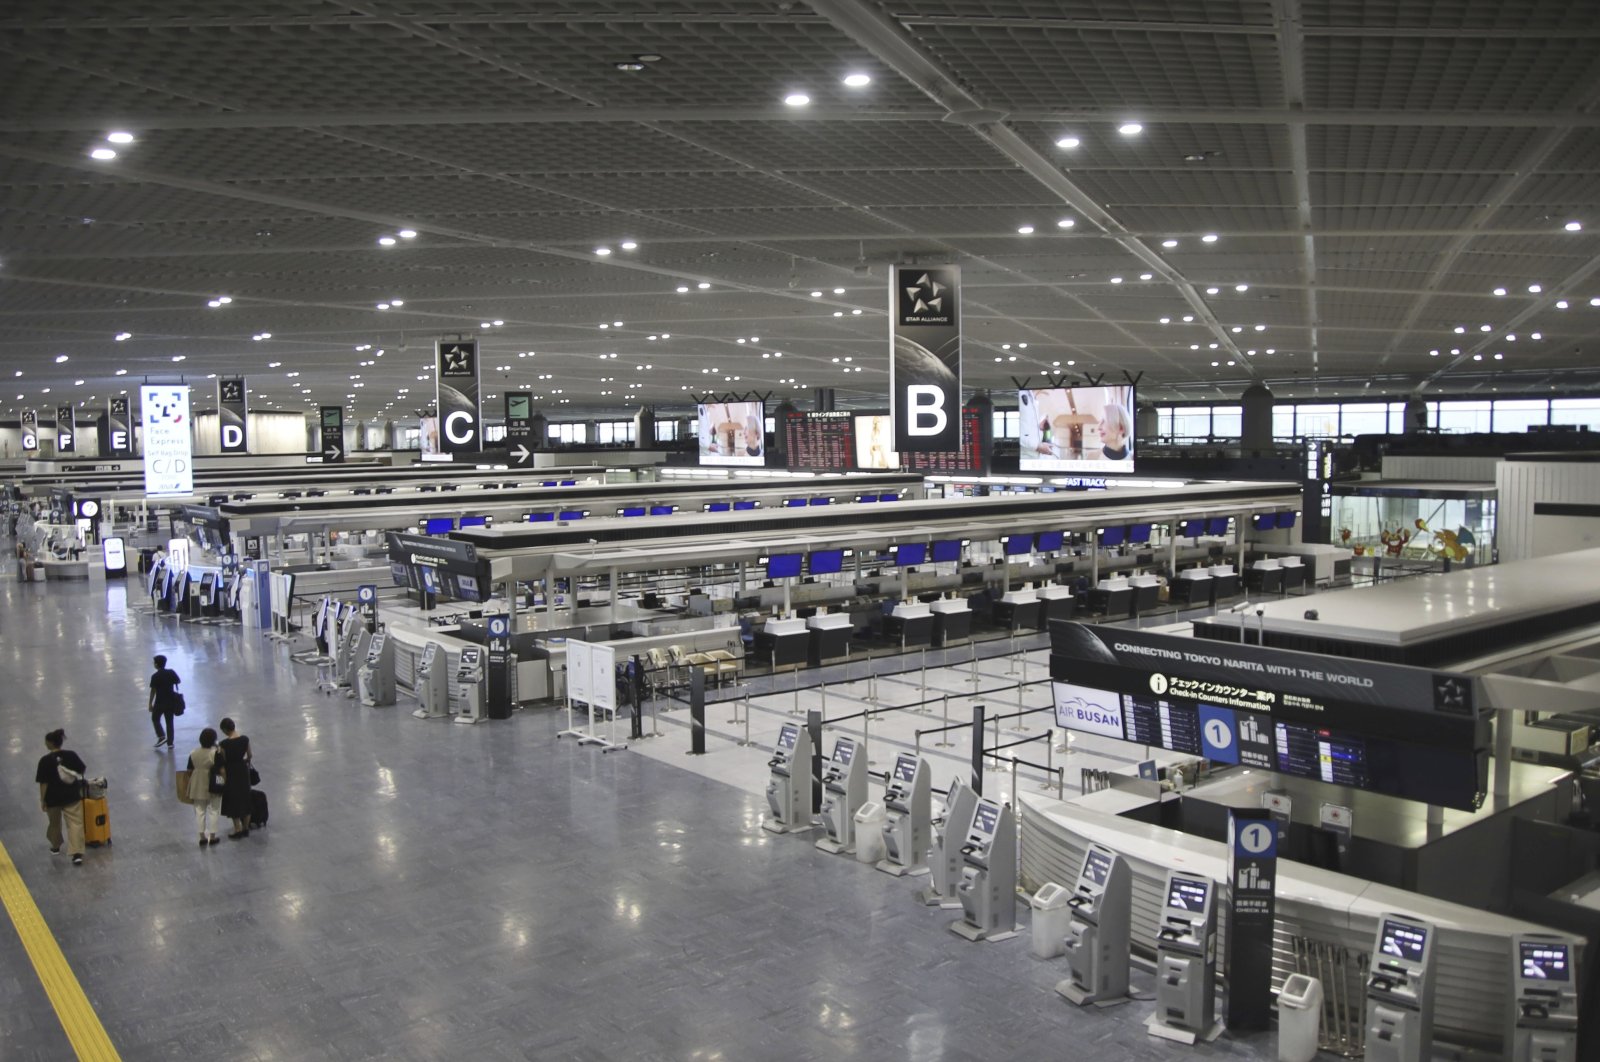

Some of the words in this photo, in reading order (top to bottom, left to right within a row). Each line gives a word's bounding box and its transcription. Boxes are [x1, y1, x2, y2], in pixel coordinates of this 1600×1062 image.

[907, 384, 947, 436] B
[223, 425, 243, 448] D
[445, 410, 474, 444] C
[23, 434, 36, 449] G
[60, 434, 72, 450] F
[112, 431, 127, 449] E
[150, 437, 184, 446] Express
[152, 459, 186, 474] C/D
[1065, 477, 1081, 487] FAST
[1082, 477, 1105, 487] TRACK
[1114, 642, 1182, 660] CONNECTING
[1184, 652, 1221, 666] TOKYO
[1223, 658, 1265, 672] NARITA
[1266, 664, 1297, 677] WITH
[1299, 669, 1324, 681] THE
[1326, 672, 1374, 688] WORLD
[1168, 687, 1198, 699] Check-in
[1198, 692, 1228, 705] Counters
[1229, 696, 1271, 712] Information
[1059, 705, 1075, 719] AIR
[1076, 708, 1120, 728] BUSAN
[1211, 724, 1222, 744] 1
[1249, 828, 1260, 848] 1
